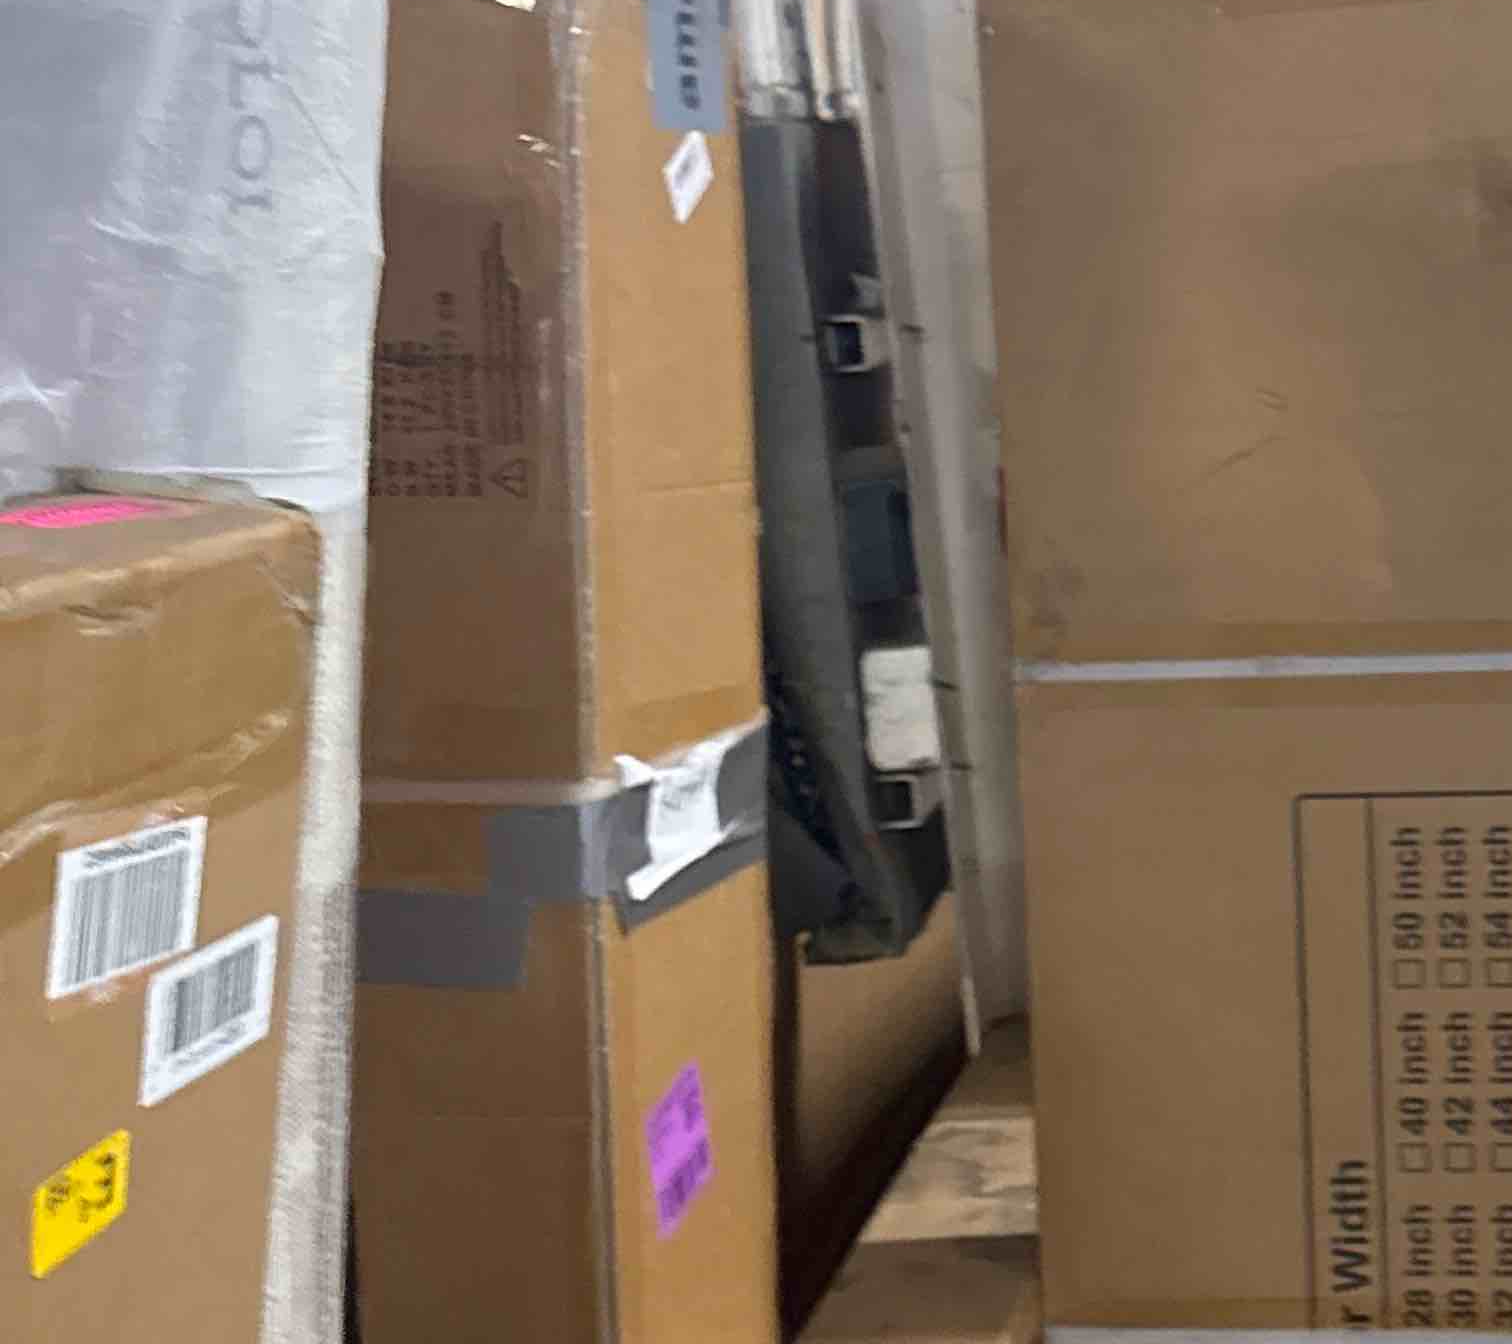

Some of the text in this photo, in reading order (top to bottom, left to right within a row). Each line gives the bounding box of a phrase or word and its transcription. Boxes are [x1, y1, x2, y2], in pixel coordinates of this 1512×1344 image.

[1389, 826, 1424, 949] 50 inch
[1436, 826, 1470, 949] 52 inch
[1396, 1011, 1429, 1136] 40 inch
[1441, 1011, 1475, 1136] 42 inch
[1329, 1159, 1372, 1294] Width
[1403, 1204, 1433, 1278] inch
[1446, 1204, 1478, 1328] 30 inch
